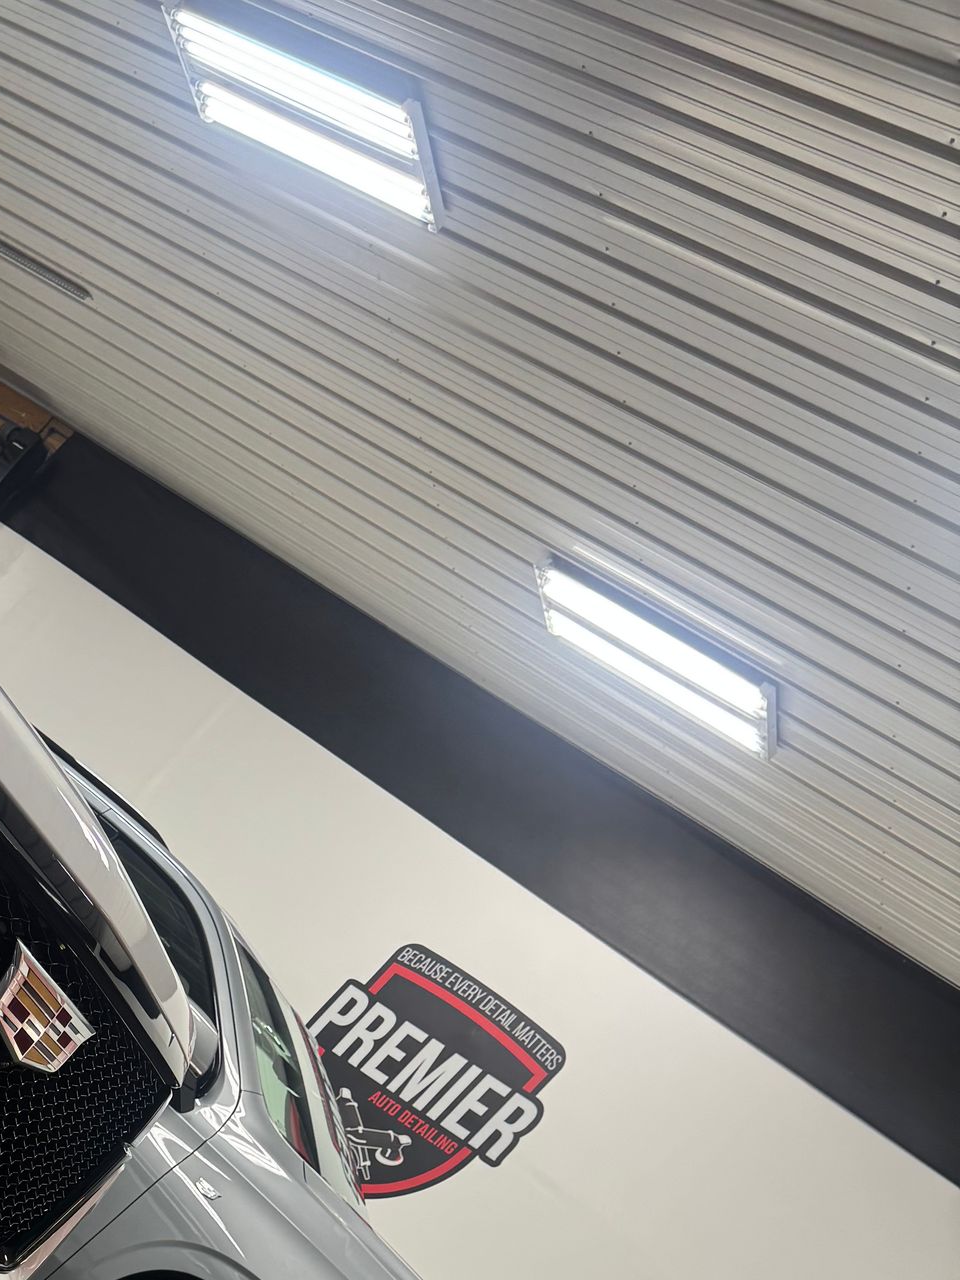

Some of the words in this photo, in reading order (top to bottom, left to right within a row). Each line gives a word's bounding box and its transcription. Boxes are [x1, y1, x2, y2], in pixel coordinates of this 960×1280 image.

[397, 947, 452, 983] BECAUSE
[444, 972, 487, 1004] EVERY
[478, 995, 518, 1031] DETAIL
[511, 1021, 563, 1071] MATTERS
[307, 984, 538, 1162] PREMIER
[367, 1091, 402, 1117] AUTO
[397, 1109, 459, 1155] DETAILING
